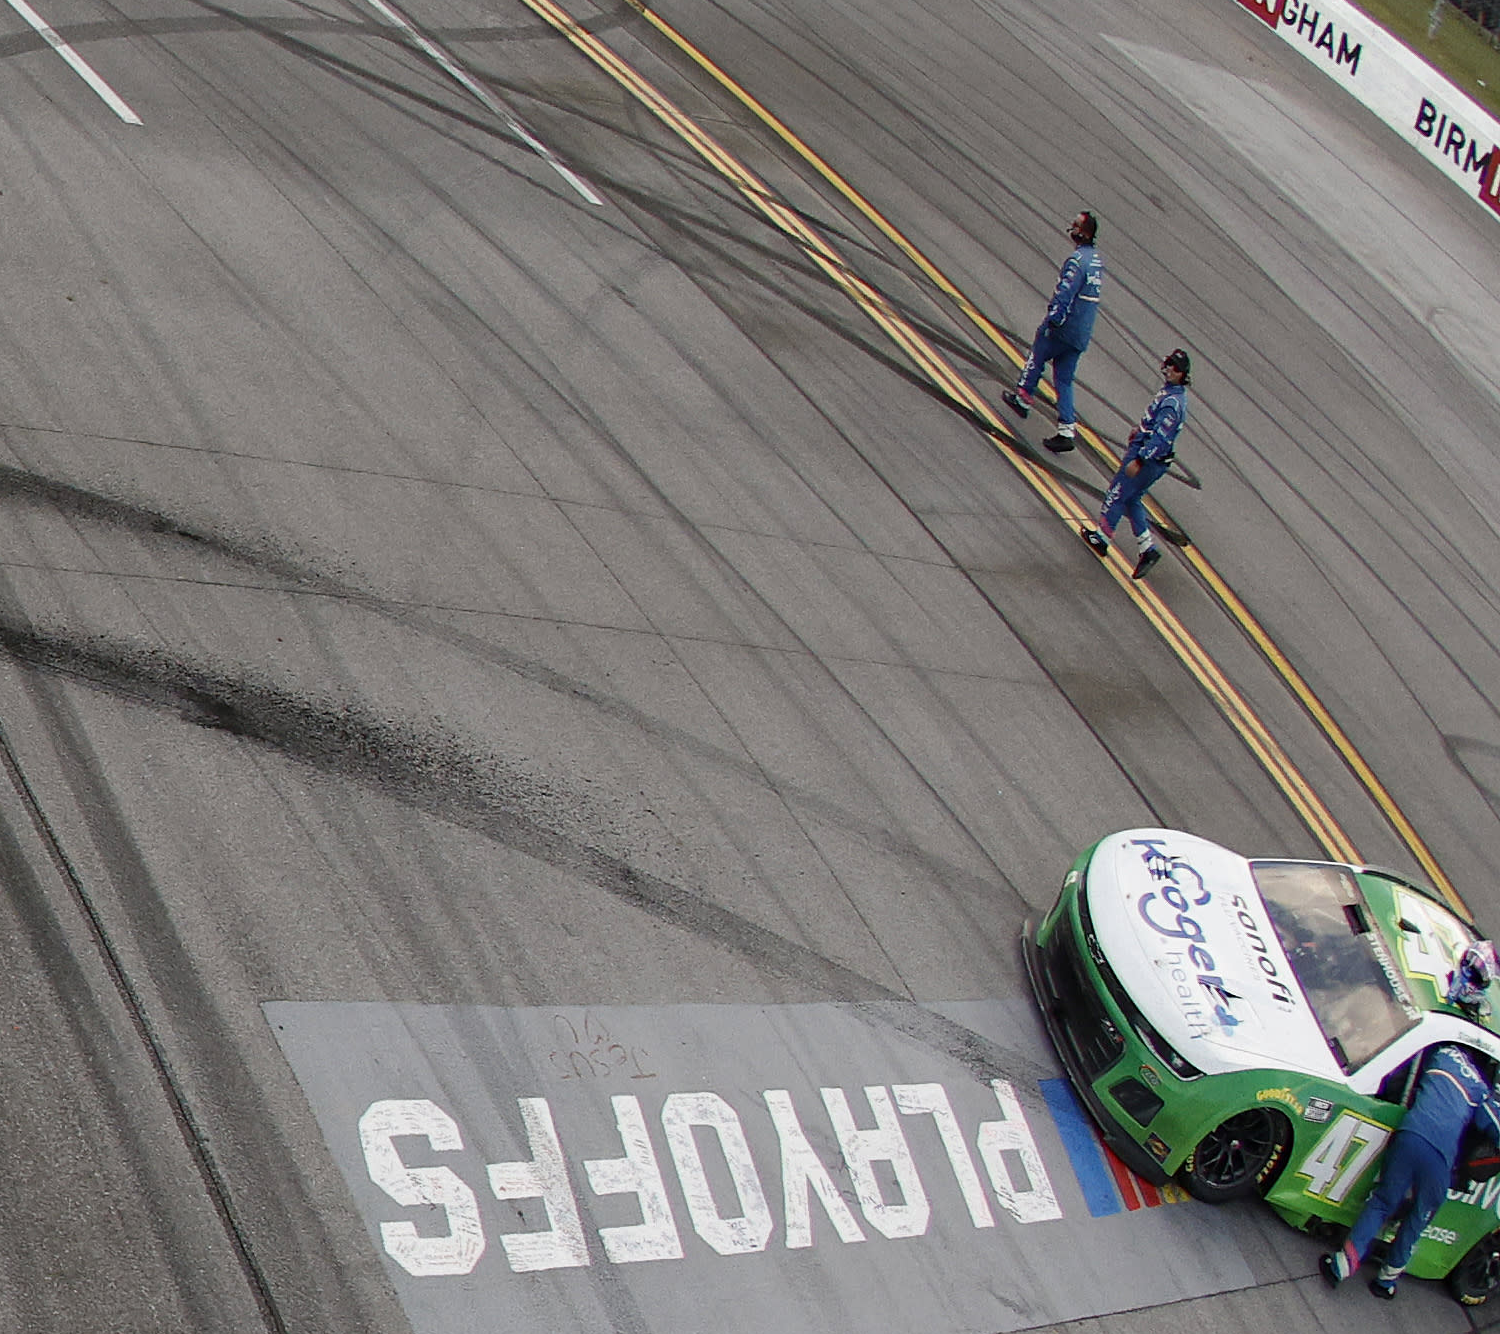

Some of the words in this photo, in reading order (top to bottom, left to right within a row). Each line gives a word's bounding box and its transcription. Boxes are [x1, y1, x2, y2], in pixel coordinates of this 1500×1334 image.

[1132, 839, 1224, 1007] Kroger
[1231, 893, 1297, 1008] sanofi
[1366, 931, 1411, 1005] STENHOUSE
[1163, 948, 1208, 1040] health
[358, 1078, 1063, 1276] PLAYOFFS
[1294, 1110, 1395, 1207] 47
